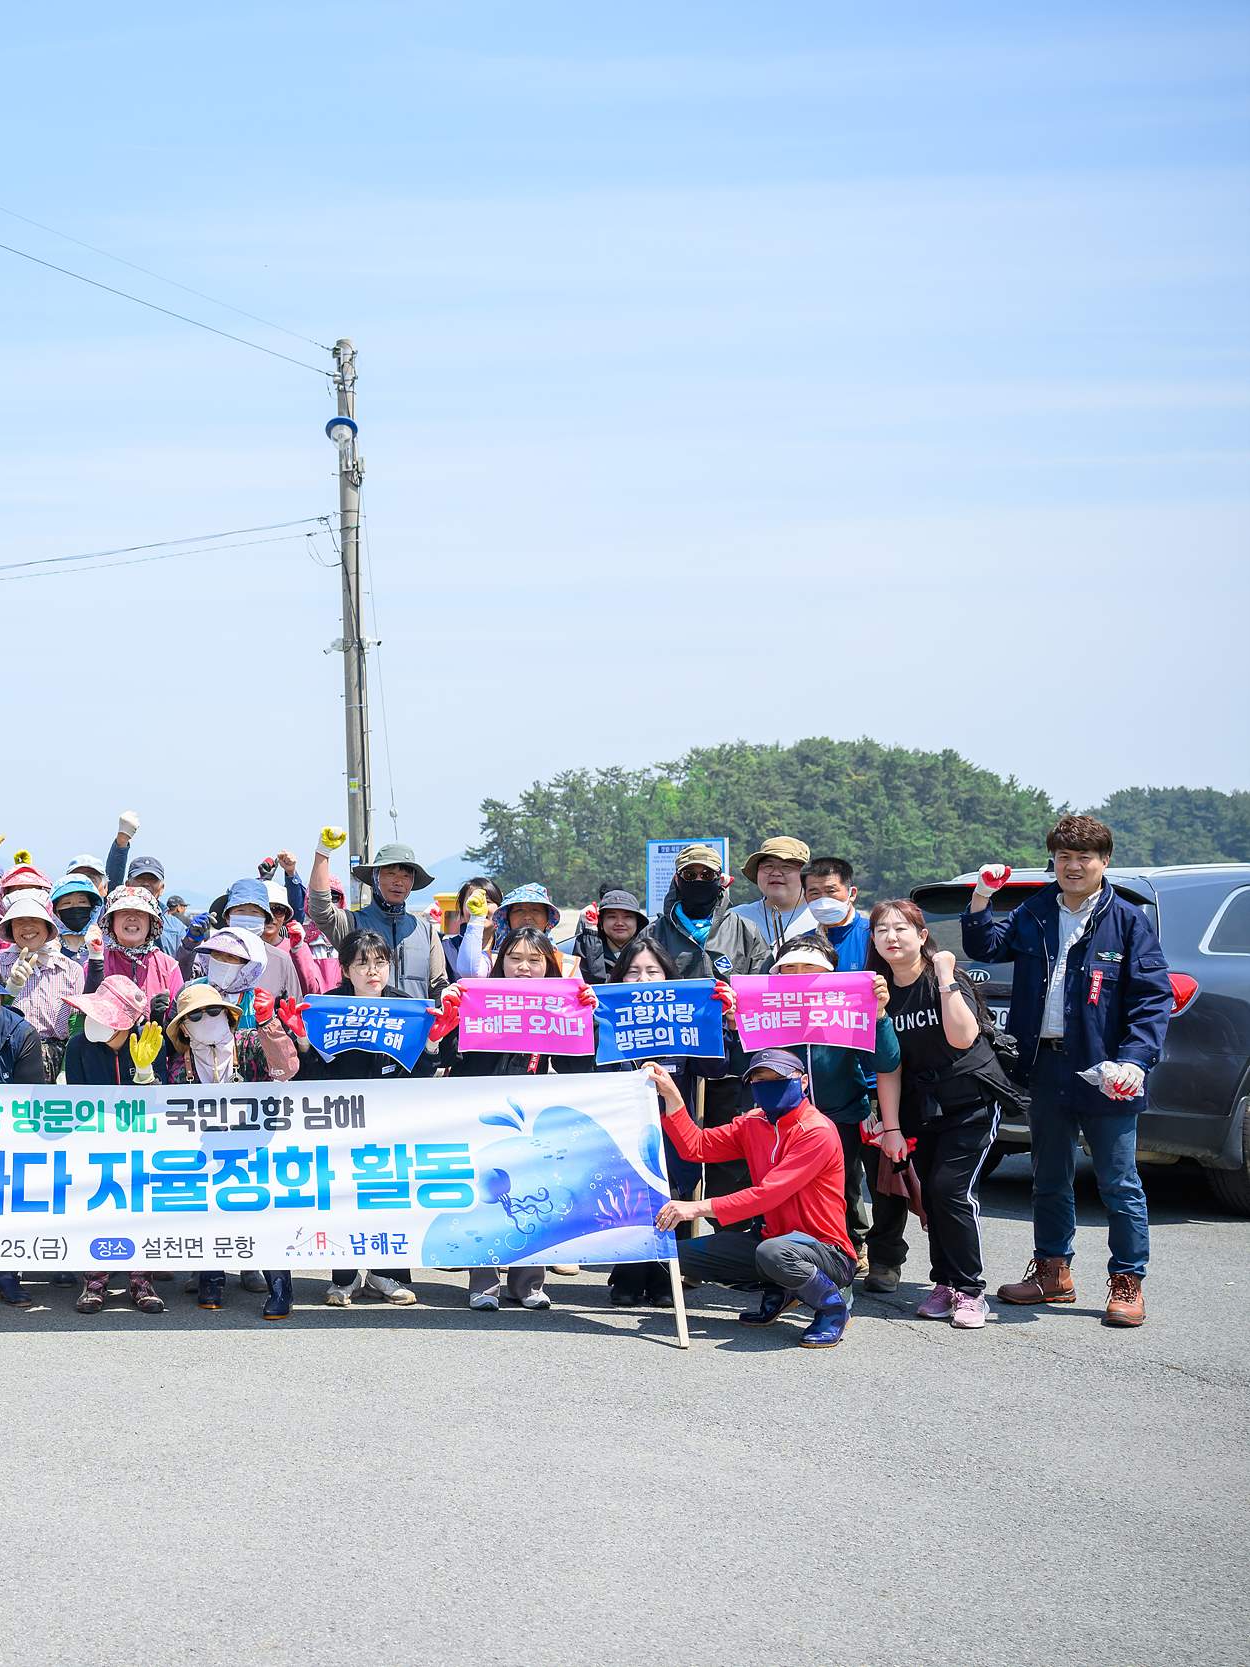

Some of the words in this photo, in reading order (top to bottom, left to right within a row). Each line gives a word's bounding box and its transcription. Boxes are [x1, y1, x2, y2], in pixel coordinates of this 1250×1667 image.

[631, 990, 676, 1004] 2025
[346, 1006, 390, 1018] 2025
[615, 1003, 695, 1027] 고향사랑
[741, 1010, 802, 1033] 남해로
[808, 1010, 870, 1031] 오시다
[464, 1015, 523, 1034] 남해로
[528, 1016, 586, 1037] 오시다
[323, 1030, 378, 1049] 방문의
[383, 1032, 405, 1050] 해
[615, 1028, 674, 1050] 방문의
[679, 1027, 700, 1047] 해
[11, 1099, 105, 1134] 방문의
[165, 1096, 295, 1132] 국민고향
[302, 1095, 366, 1130] 남해
[87, 1145, 336, 1213] 자율정화
[350, 1142, 476, 1210] 활동
[0, 1236, 69, 1261] 25.(금)
[96, 1240, 128, 1257] 장소
[141, 1236, 205, 1260] 설천면
[212, 1236, 256, 1260] 문항
[349, 1232, 409, 1256] 남해군
